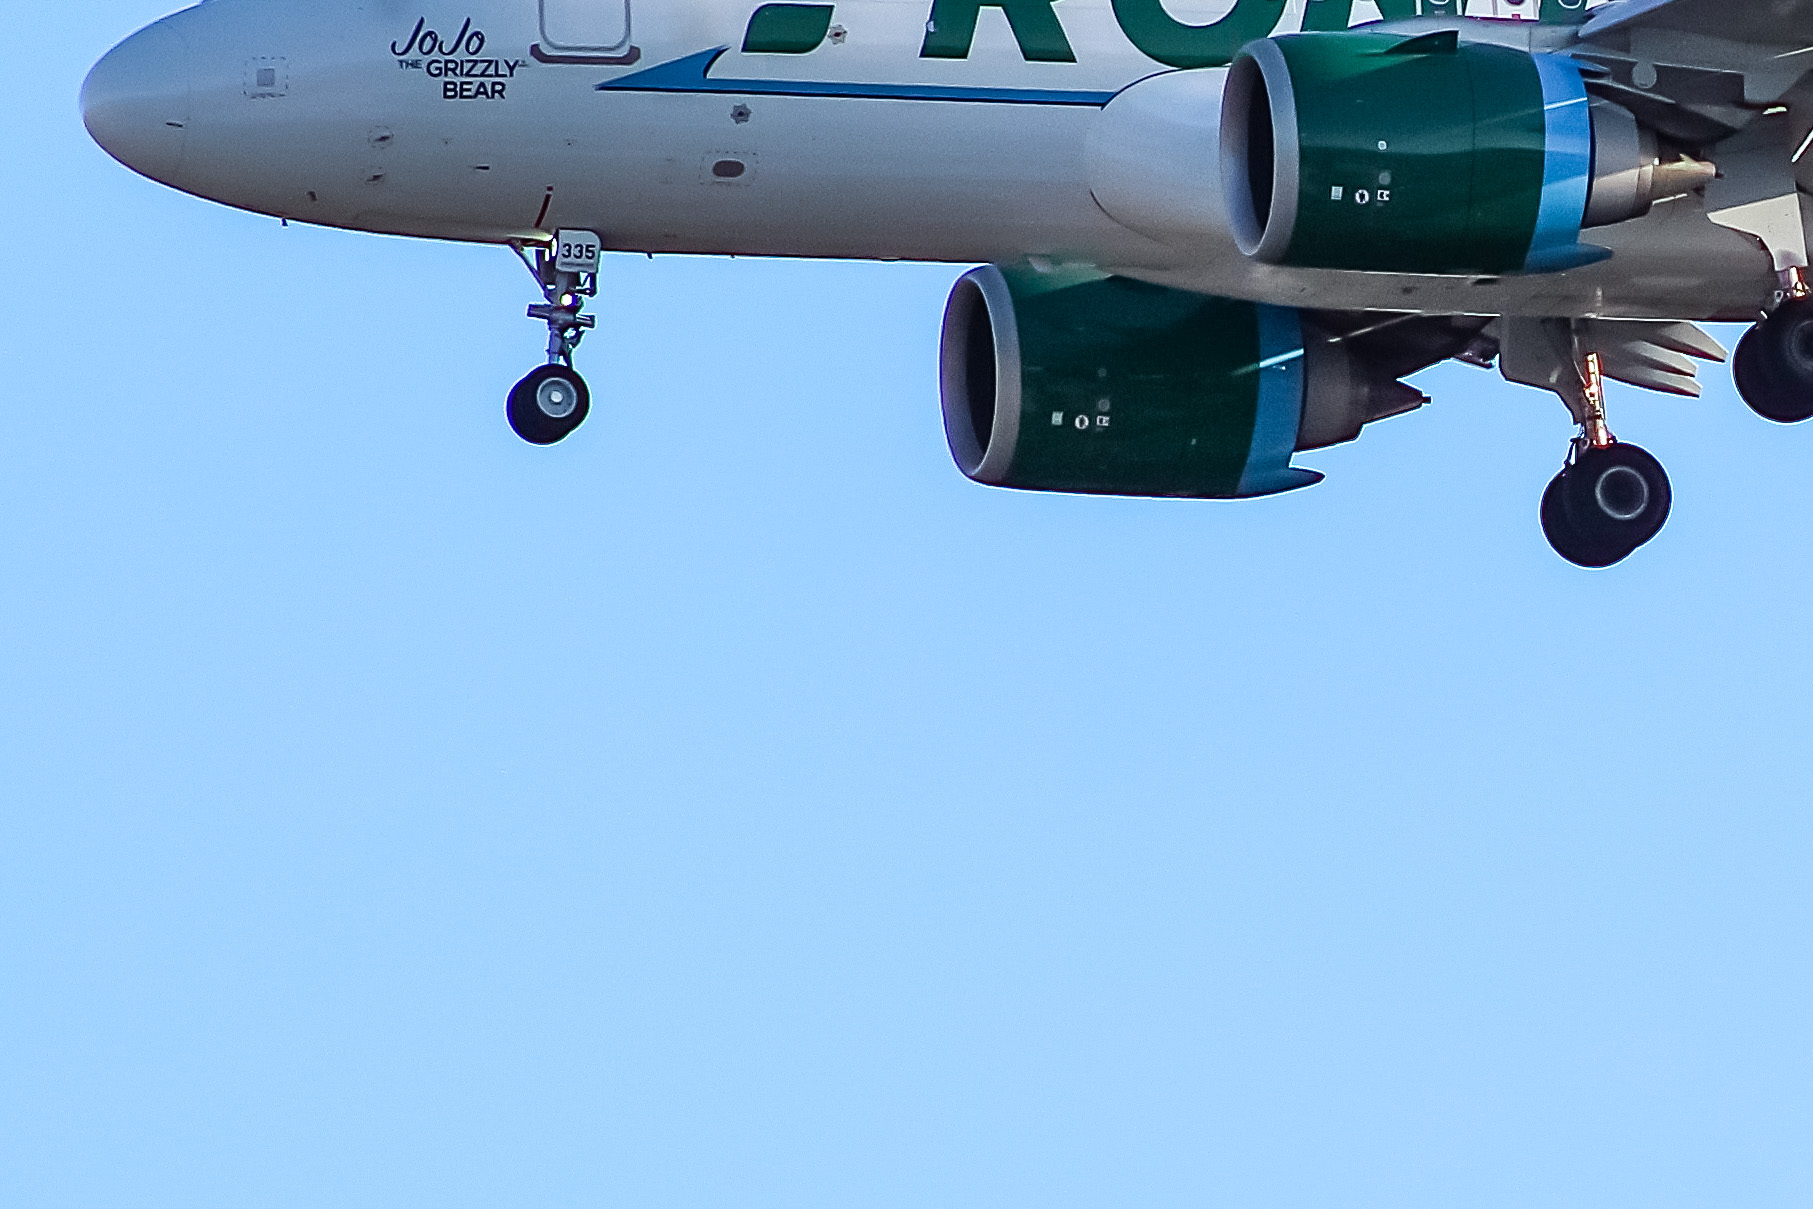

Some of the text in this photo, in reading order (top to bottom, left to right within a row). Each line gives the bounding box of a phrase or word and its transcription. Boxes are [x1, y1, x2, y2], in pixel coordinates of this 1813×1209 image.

[390, 16, 486, 56] JoJo
[398, 59, 423, 70] THE
[426, 59, 519, 78] GRIZZLY
[442, 80, 506, 100] BEAR
[561, 242, 596, 260] 335
